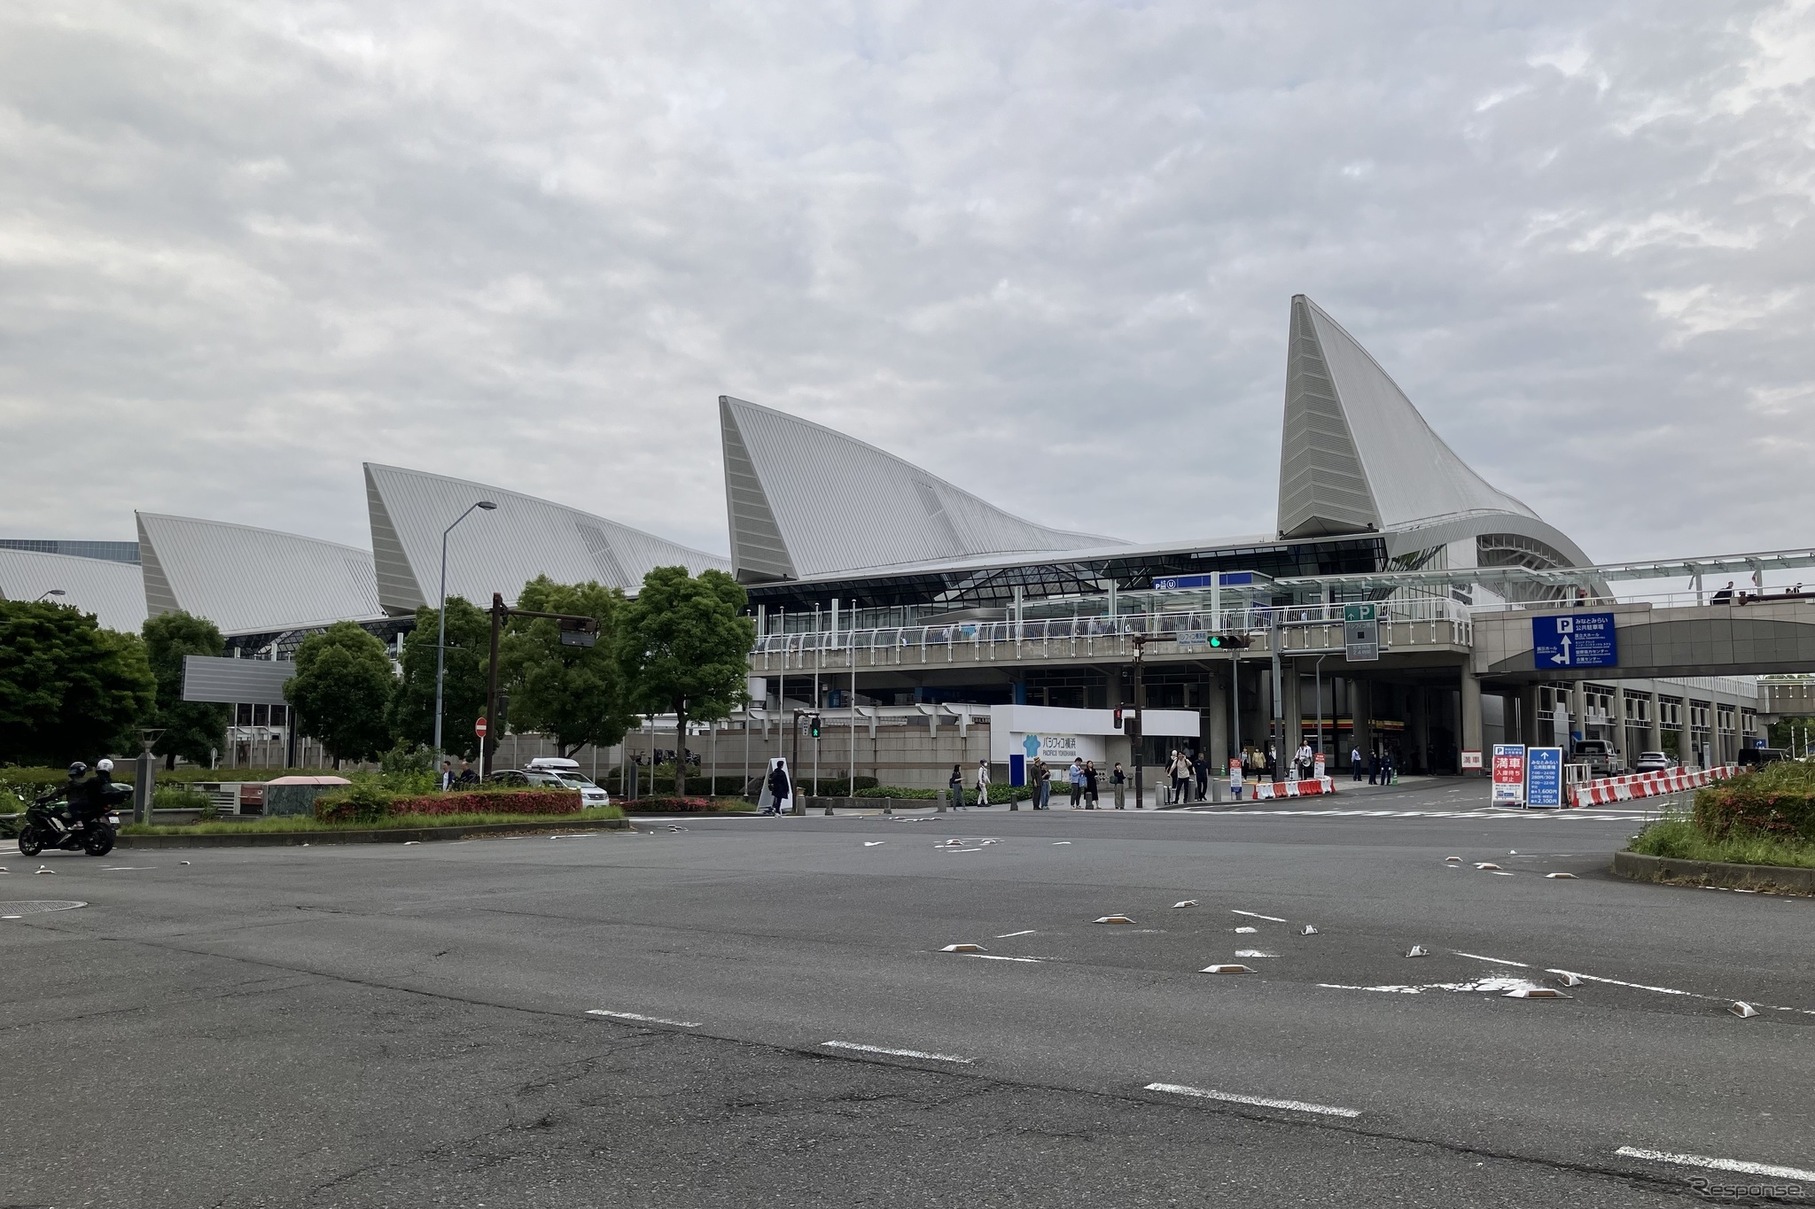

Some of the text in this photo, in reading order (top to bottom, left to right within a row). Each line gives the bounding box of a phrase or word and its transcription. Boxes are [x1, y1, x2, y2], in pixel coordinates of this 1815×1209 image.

[1359, 606, 1370, 620] P
[1561, 620, 1570, 631] P
[1043, 737, 1076, 749] パシフィコ横浜
[1043, 749, 1057, 757] PACIFICO
[1497, 747, 1503, 755] P
[1496, 757, 1521, 769] 満車
